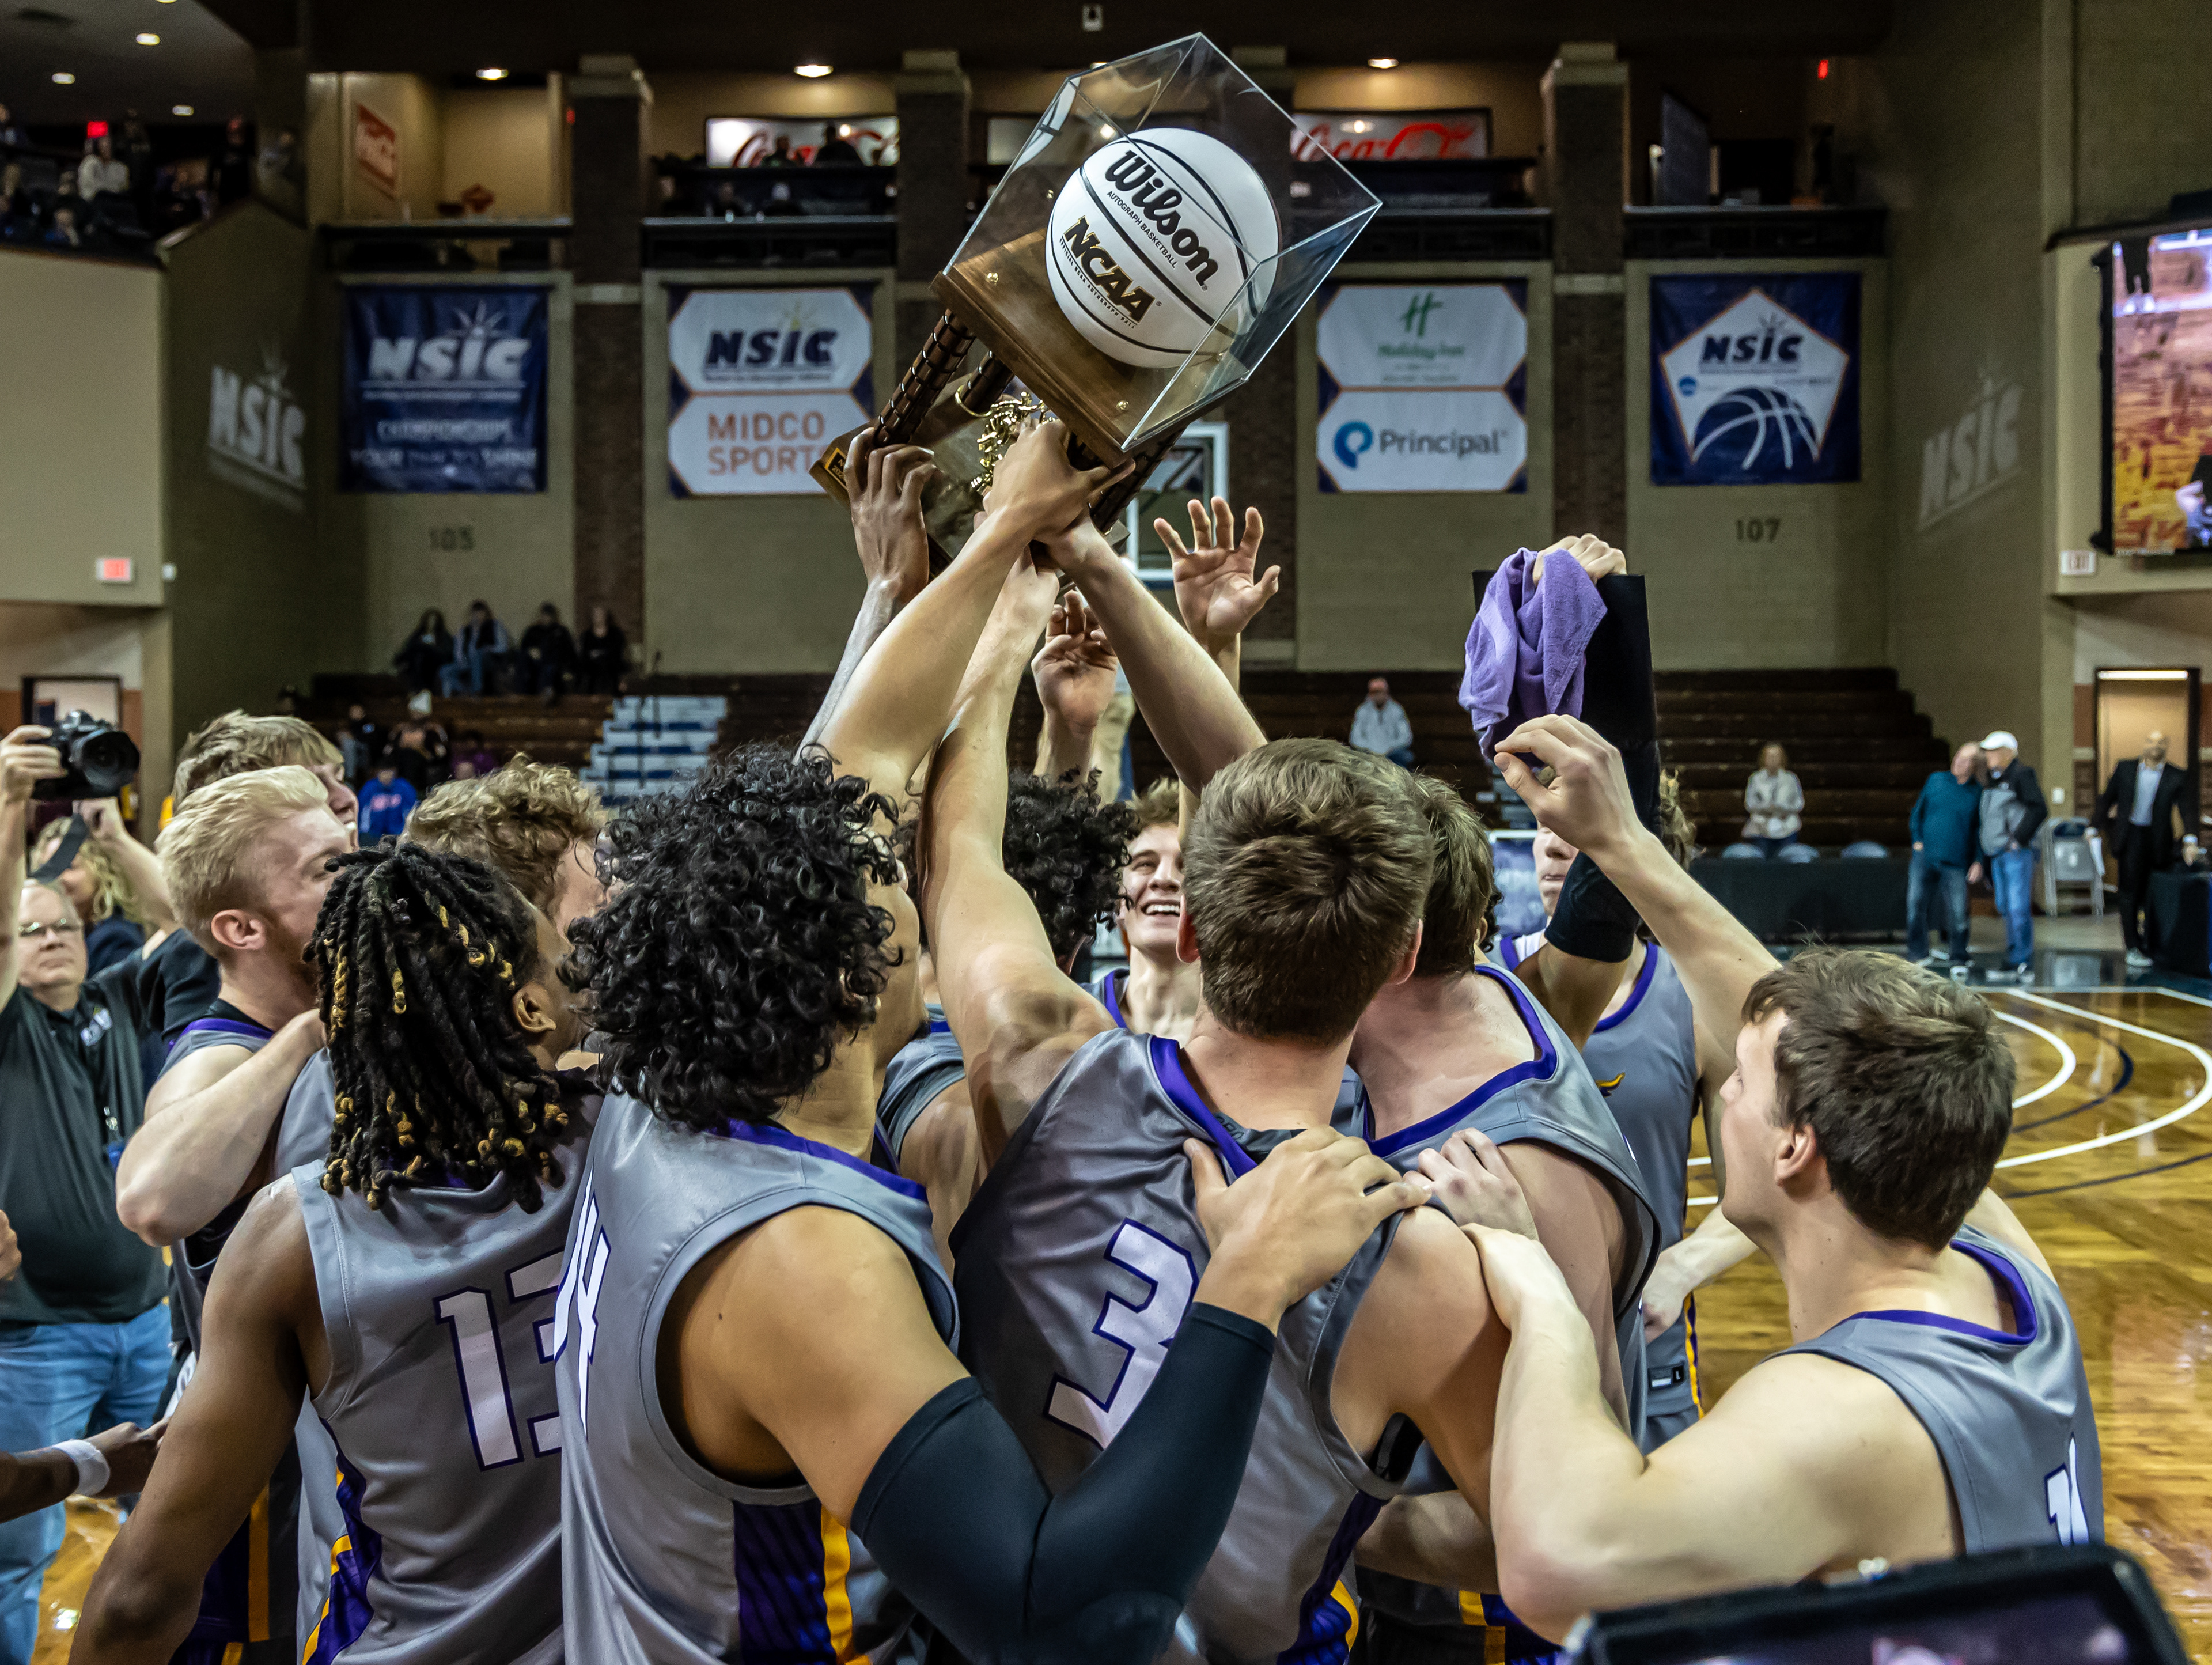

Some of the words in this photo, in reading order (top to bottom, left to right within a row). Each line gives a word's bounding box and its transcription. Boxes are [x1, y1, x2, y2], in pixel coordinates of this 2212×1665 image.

[1105, 150, 1219, 288] Wilson
[1107, 191, 1142, 226] AUTOGRAPH
[1140, 222, 1177, 268] BASKETBALL
[1059, 238, 1074, 266] OFFICIAL
[1074, 266, 1086, 283] NCAA
[1087, 284, 1119, 316] AUTOGRAPH
[1121, 316, 1136, 330] BALL
[1064, 215, 1156, 323] NCAA
[707, 330, 839, 365] NSIC
[707, 410, 825, 442] MIDCO
[1379, 428, 1501, 460] Principal
[831, 465, 844, 479] 202
[1736, 519, 1781, 543] 107
[1043, 1217, 1200, 1451] 3
